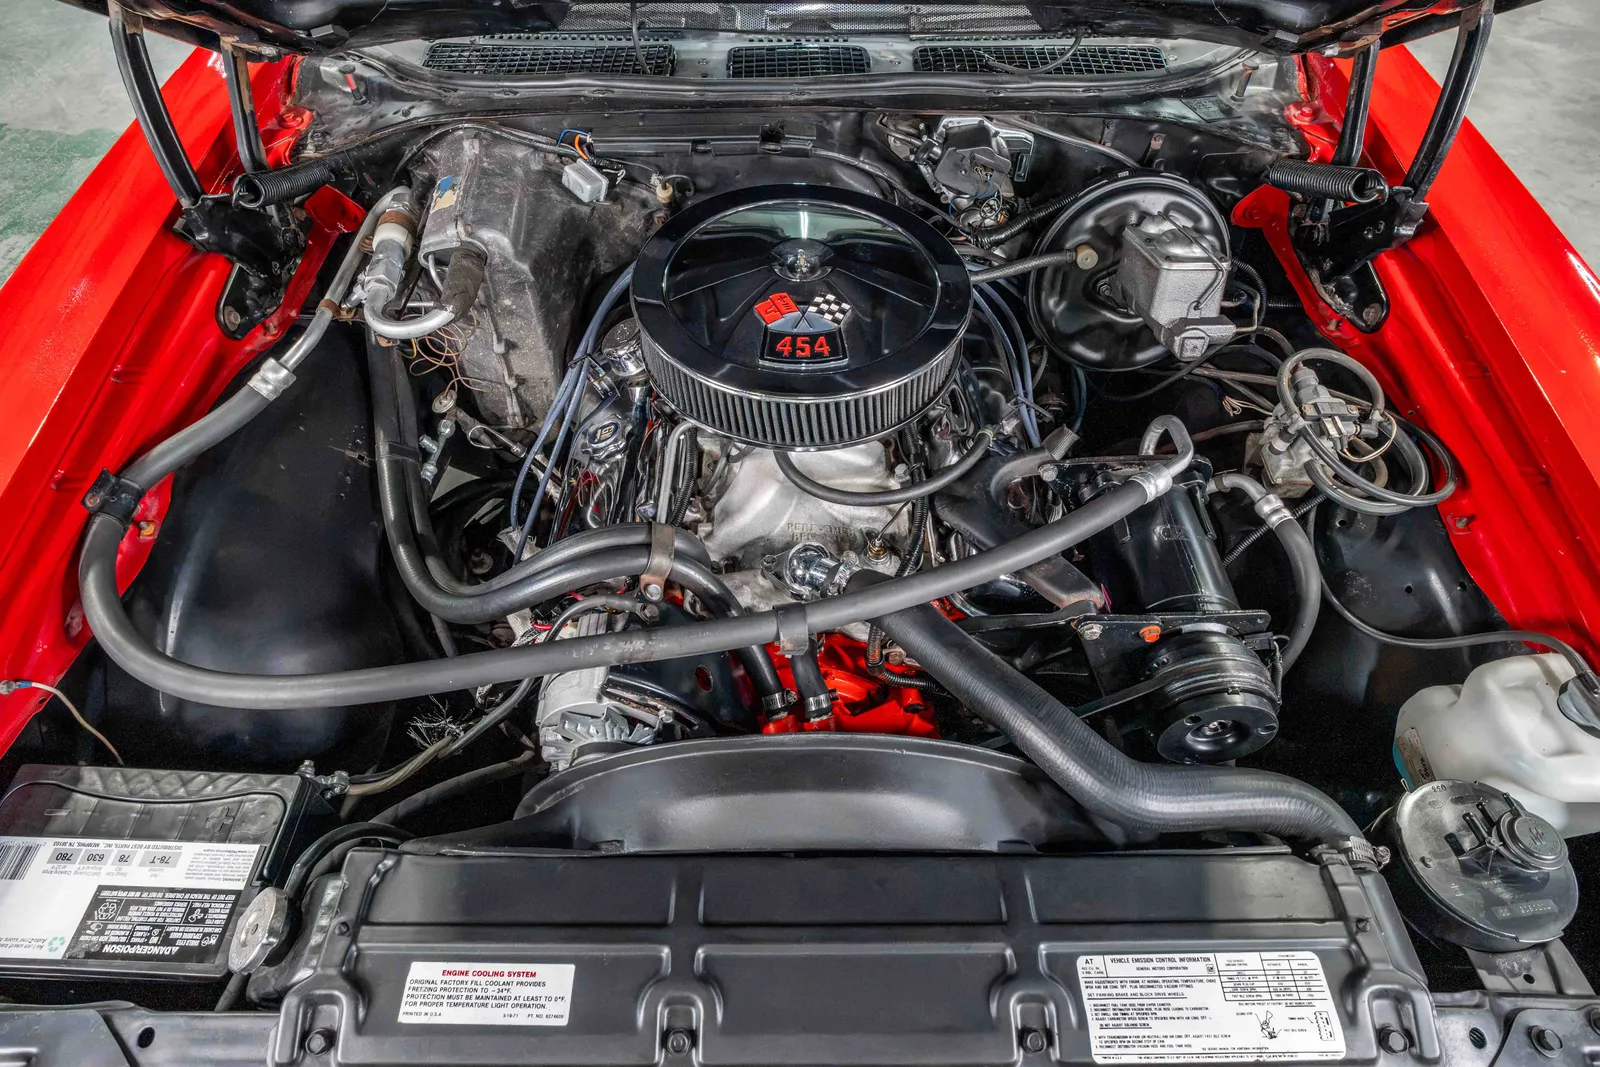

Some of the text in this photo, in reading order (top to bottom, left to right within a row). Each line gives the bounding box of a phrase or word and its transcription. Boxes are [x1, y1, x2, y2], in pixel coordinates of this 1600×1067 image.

[776, 336, 830, 357] 454
[56, 853, 73, 861] 780
[118, 854, 130, 863] 78
[149, 856, 171, 864] 78-T
[149, 936, 159, 944] NO
[507, 970, 537, 978] SYSTEM
